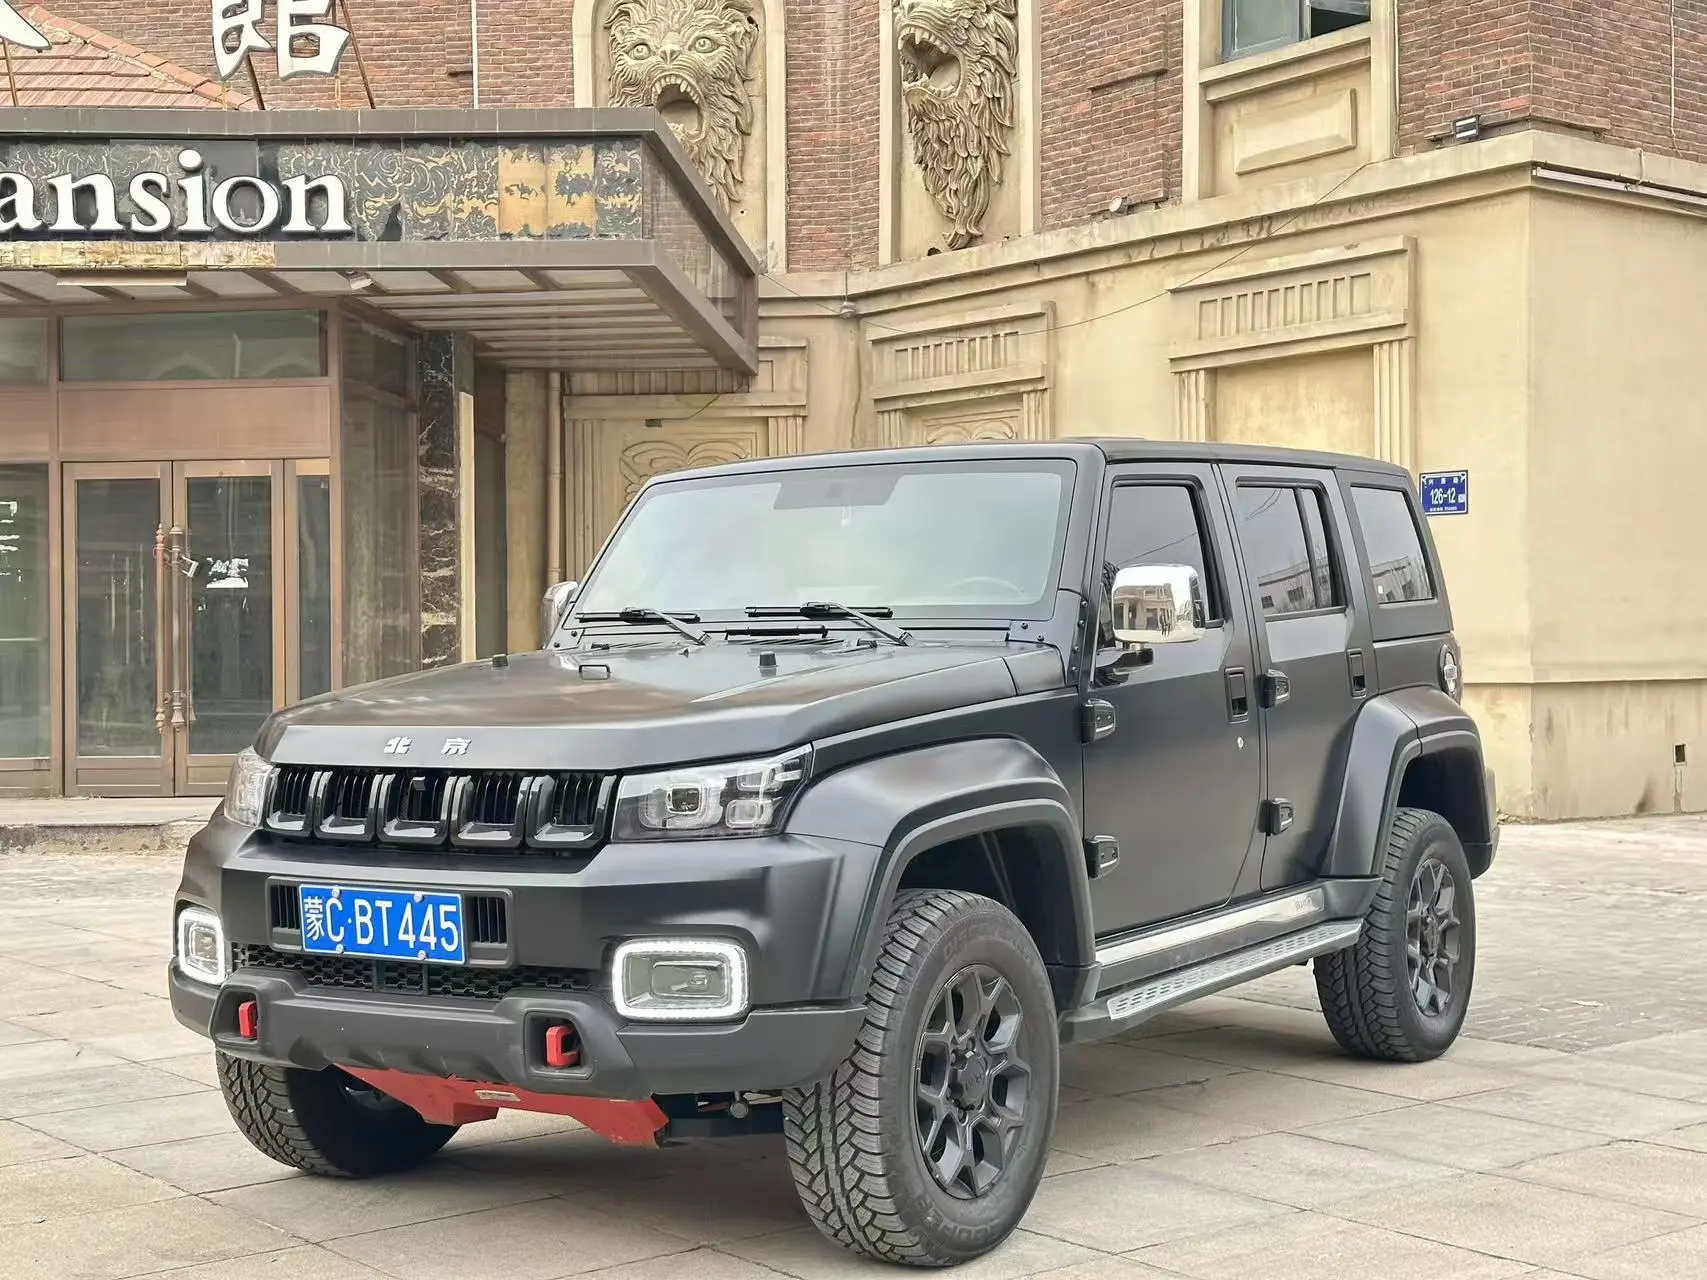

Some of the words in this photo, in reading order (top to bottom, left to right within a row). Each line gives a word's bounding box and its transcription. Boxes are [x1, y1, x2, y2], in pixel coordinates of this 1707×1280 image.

[0, 149, 354, 233] ansion
[1429, 487, 1456, 505] 126-12
[383, 736, 472, 756] 北京
